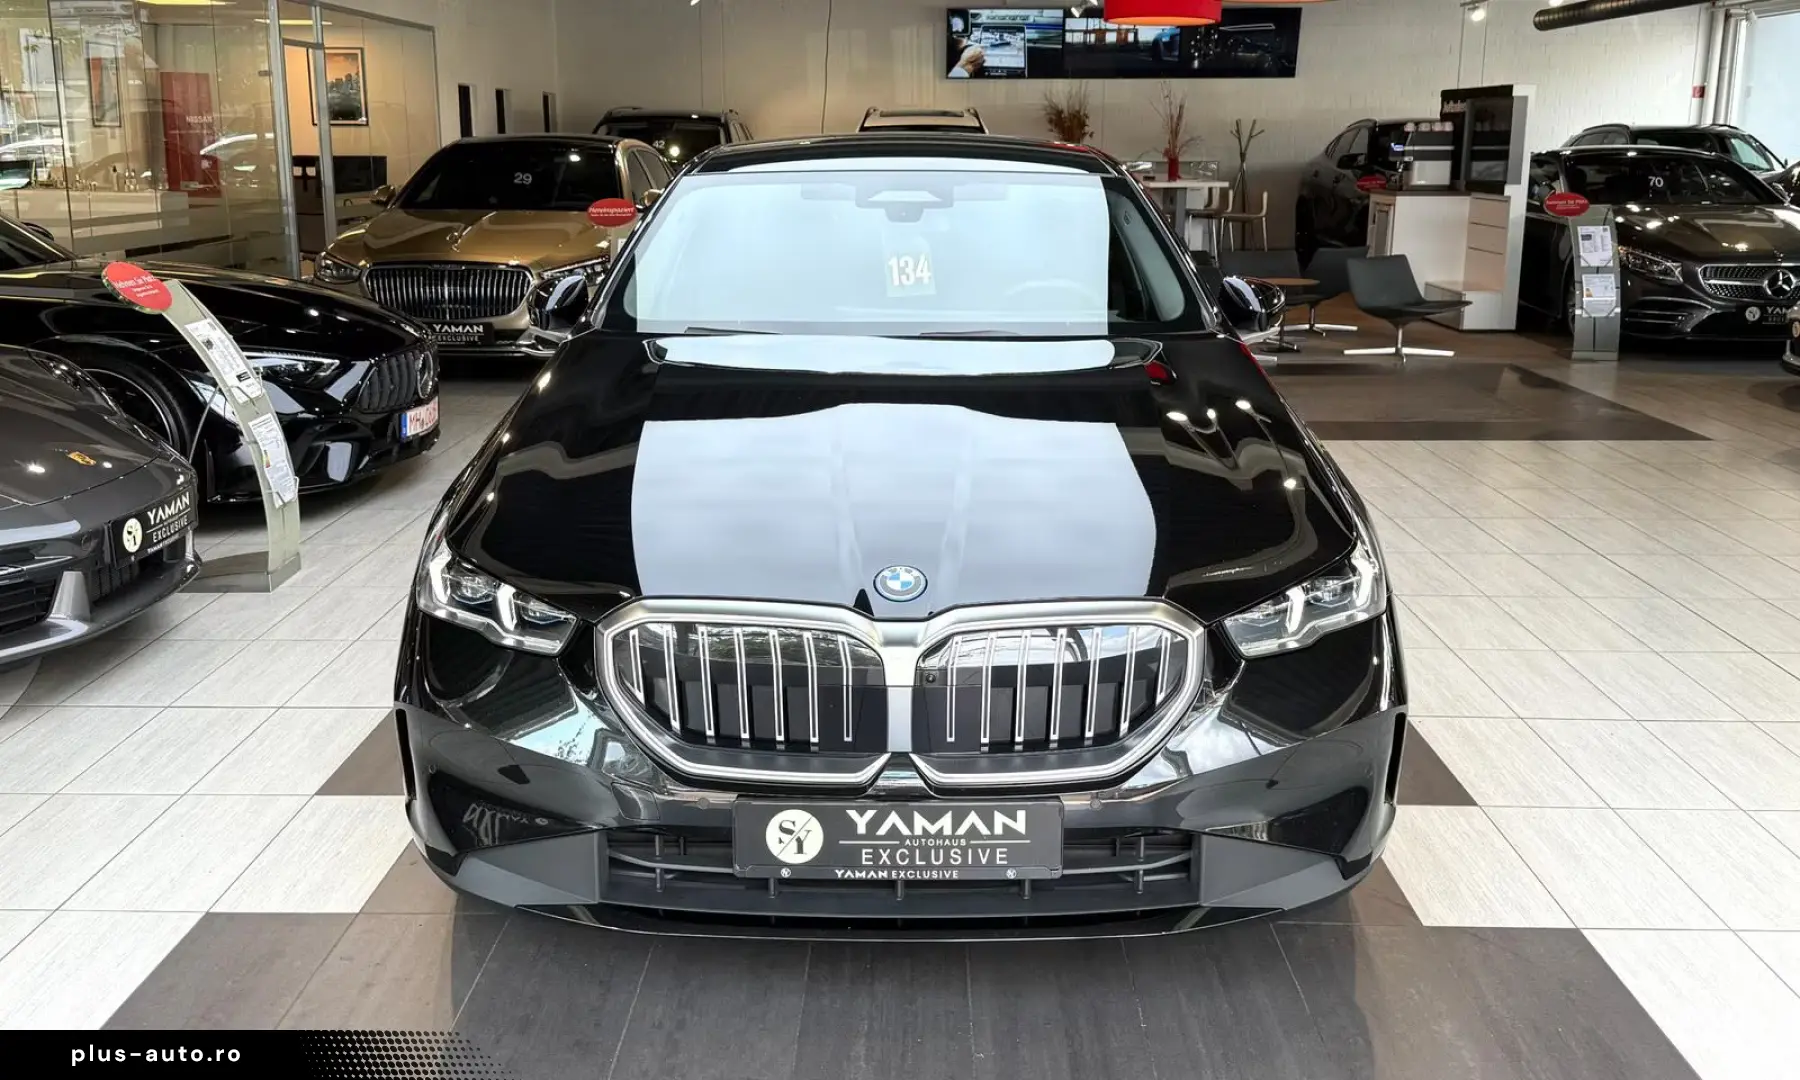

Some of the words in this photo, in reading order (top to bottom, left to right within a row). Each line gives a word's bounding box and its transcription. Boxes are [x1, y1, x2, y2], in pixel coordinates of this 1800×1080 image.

[514, 171, 533, 185] 29
[1648, 175, 1664, 188] 70
[888, 254, 931, 286] 134
[432, 323, 484, 333] YAMAN
[146, 491, 190, 526] YAMAN
[152, 514, 188, 543] EXCLUSIVE
[845, 809, 1027, 836] YAMAN
[904, 838, 967, 846] AUTOHAUS
[861, 848, 1008, 865] EXCLUSIVE
[834, 869, 889, 879] YAMAN
[891, 870, 959, 879] EXCLUSIVE
